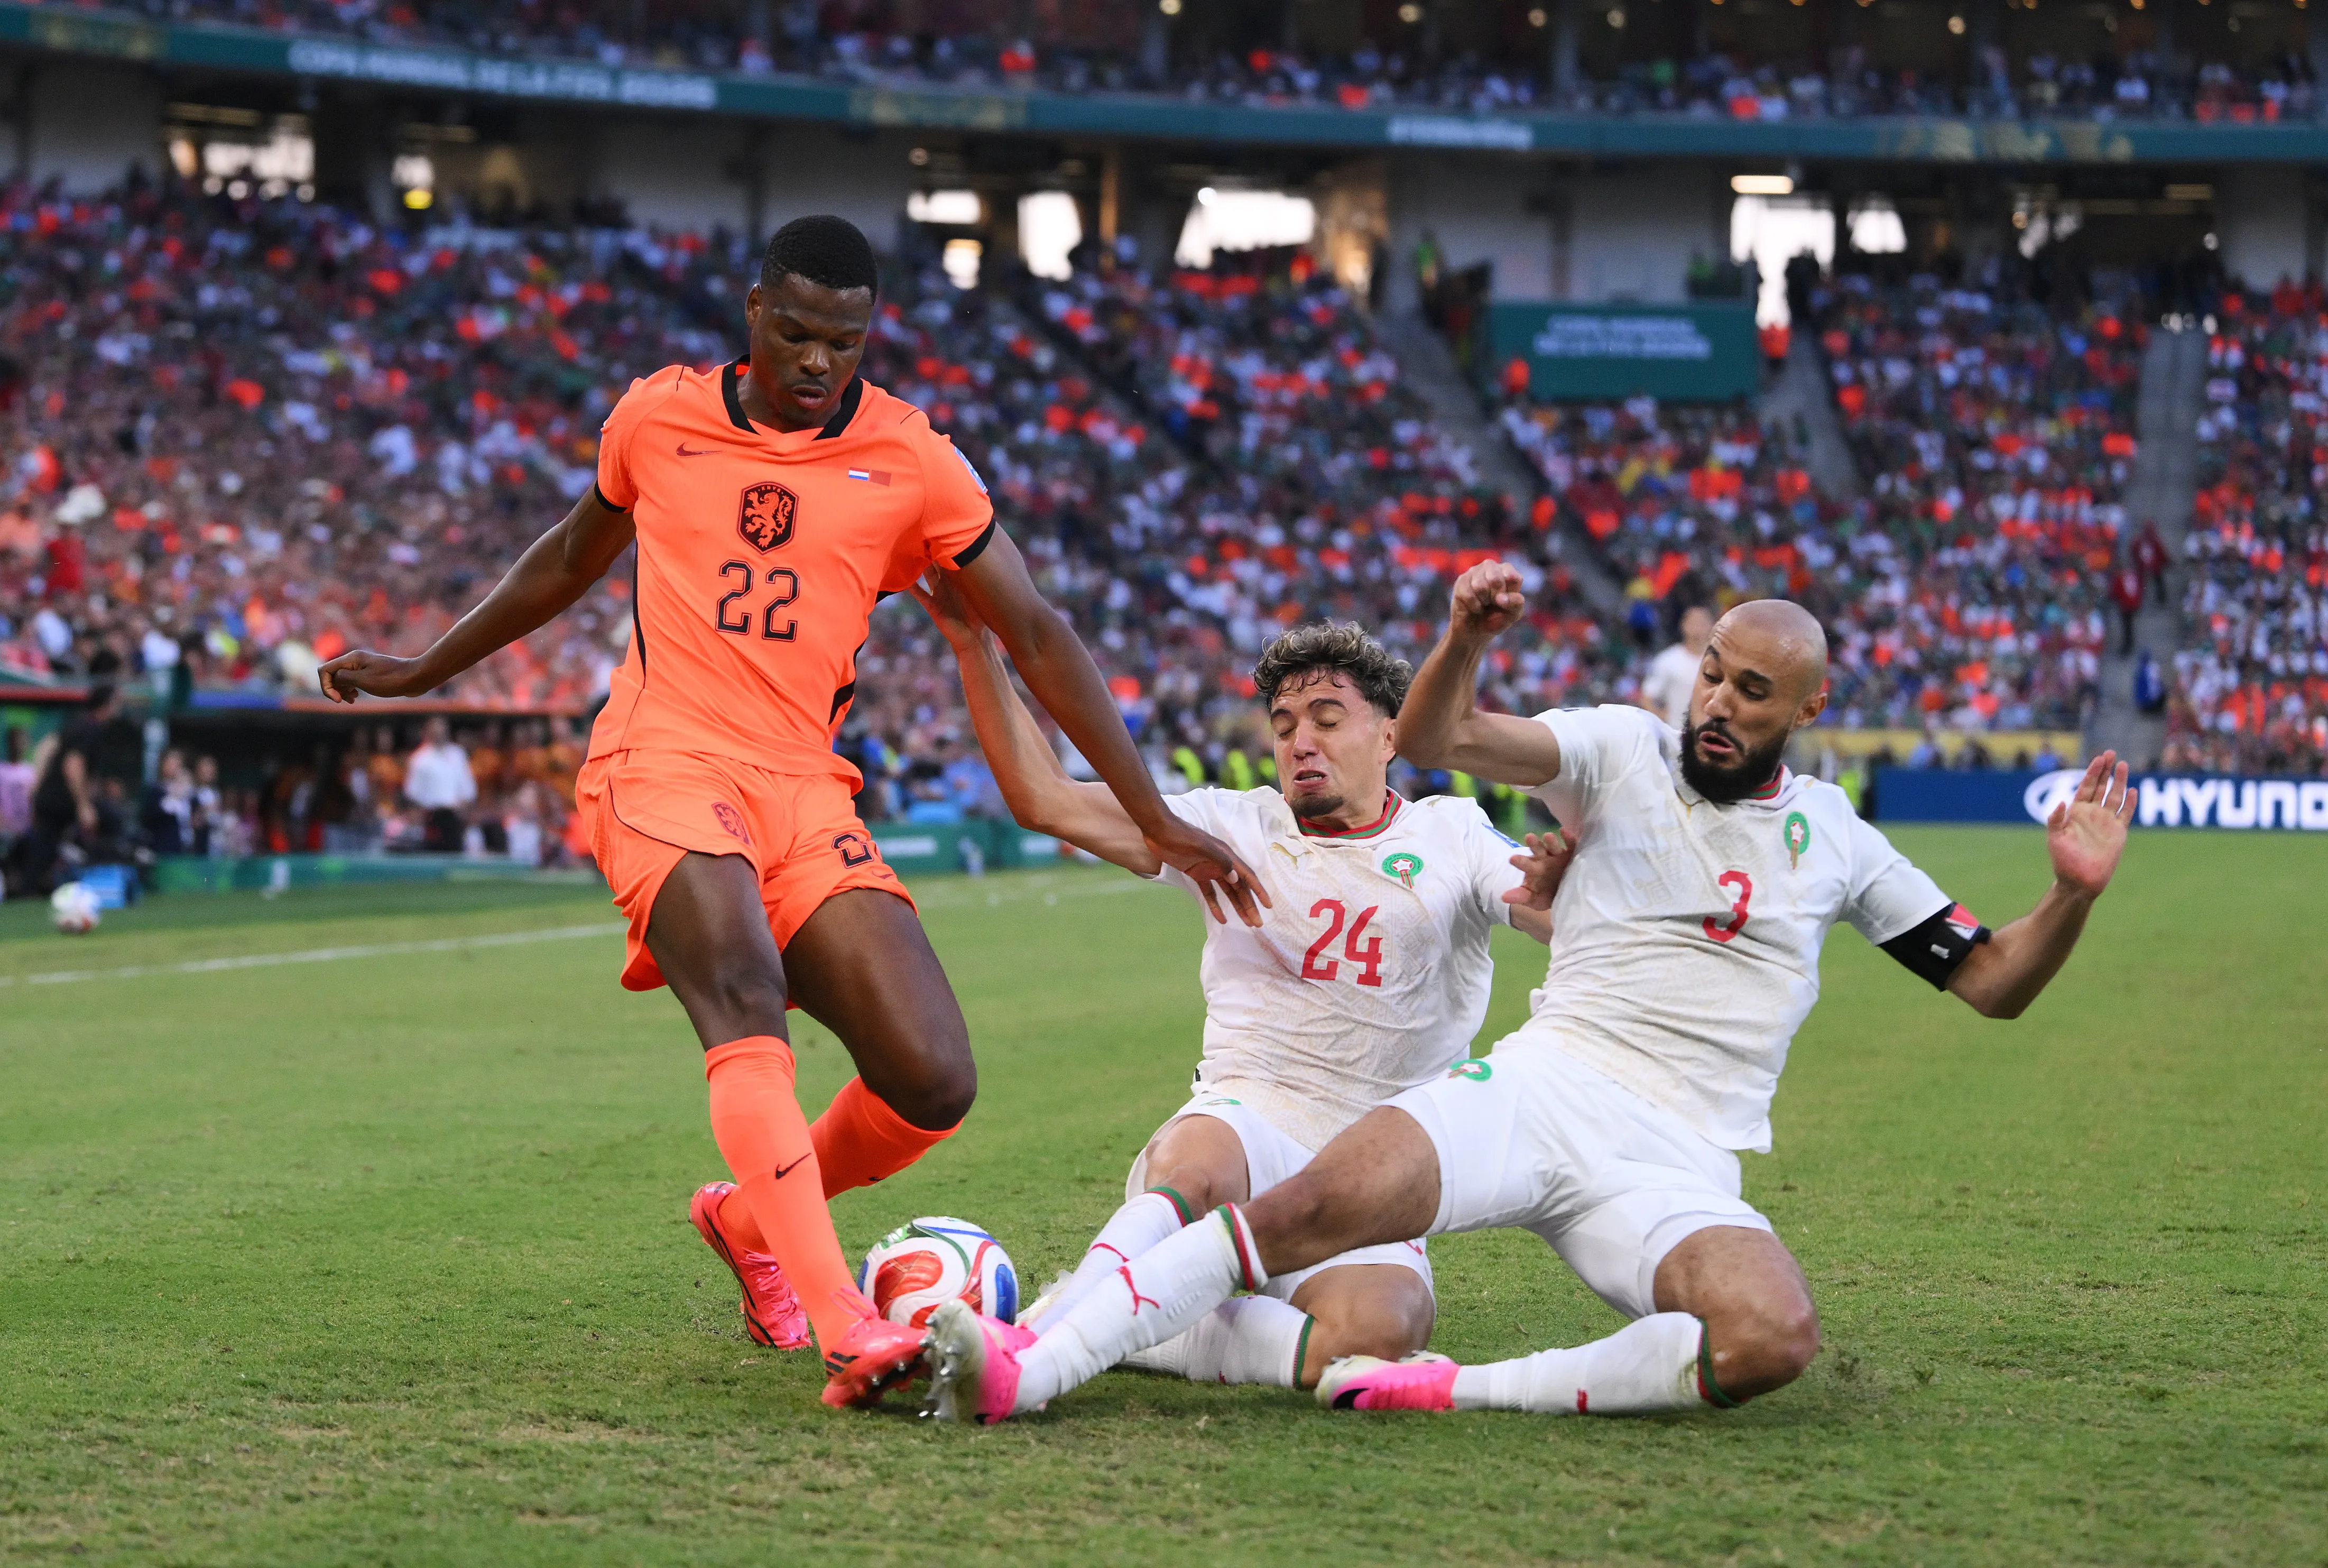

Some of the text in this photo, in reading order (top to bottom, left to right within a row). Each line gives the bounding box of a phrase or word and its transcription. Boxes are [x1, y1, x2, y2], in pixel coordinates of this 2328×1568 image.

[716, 560, 800, 642] 22
[1301, 898, 1383, 987] 24
[1702, 870, 1753, 943] 3
